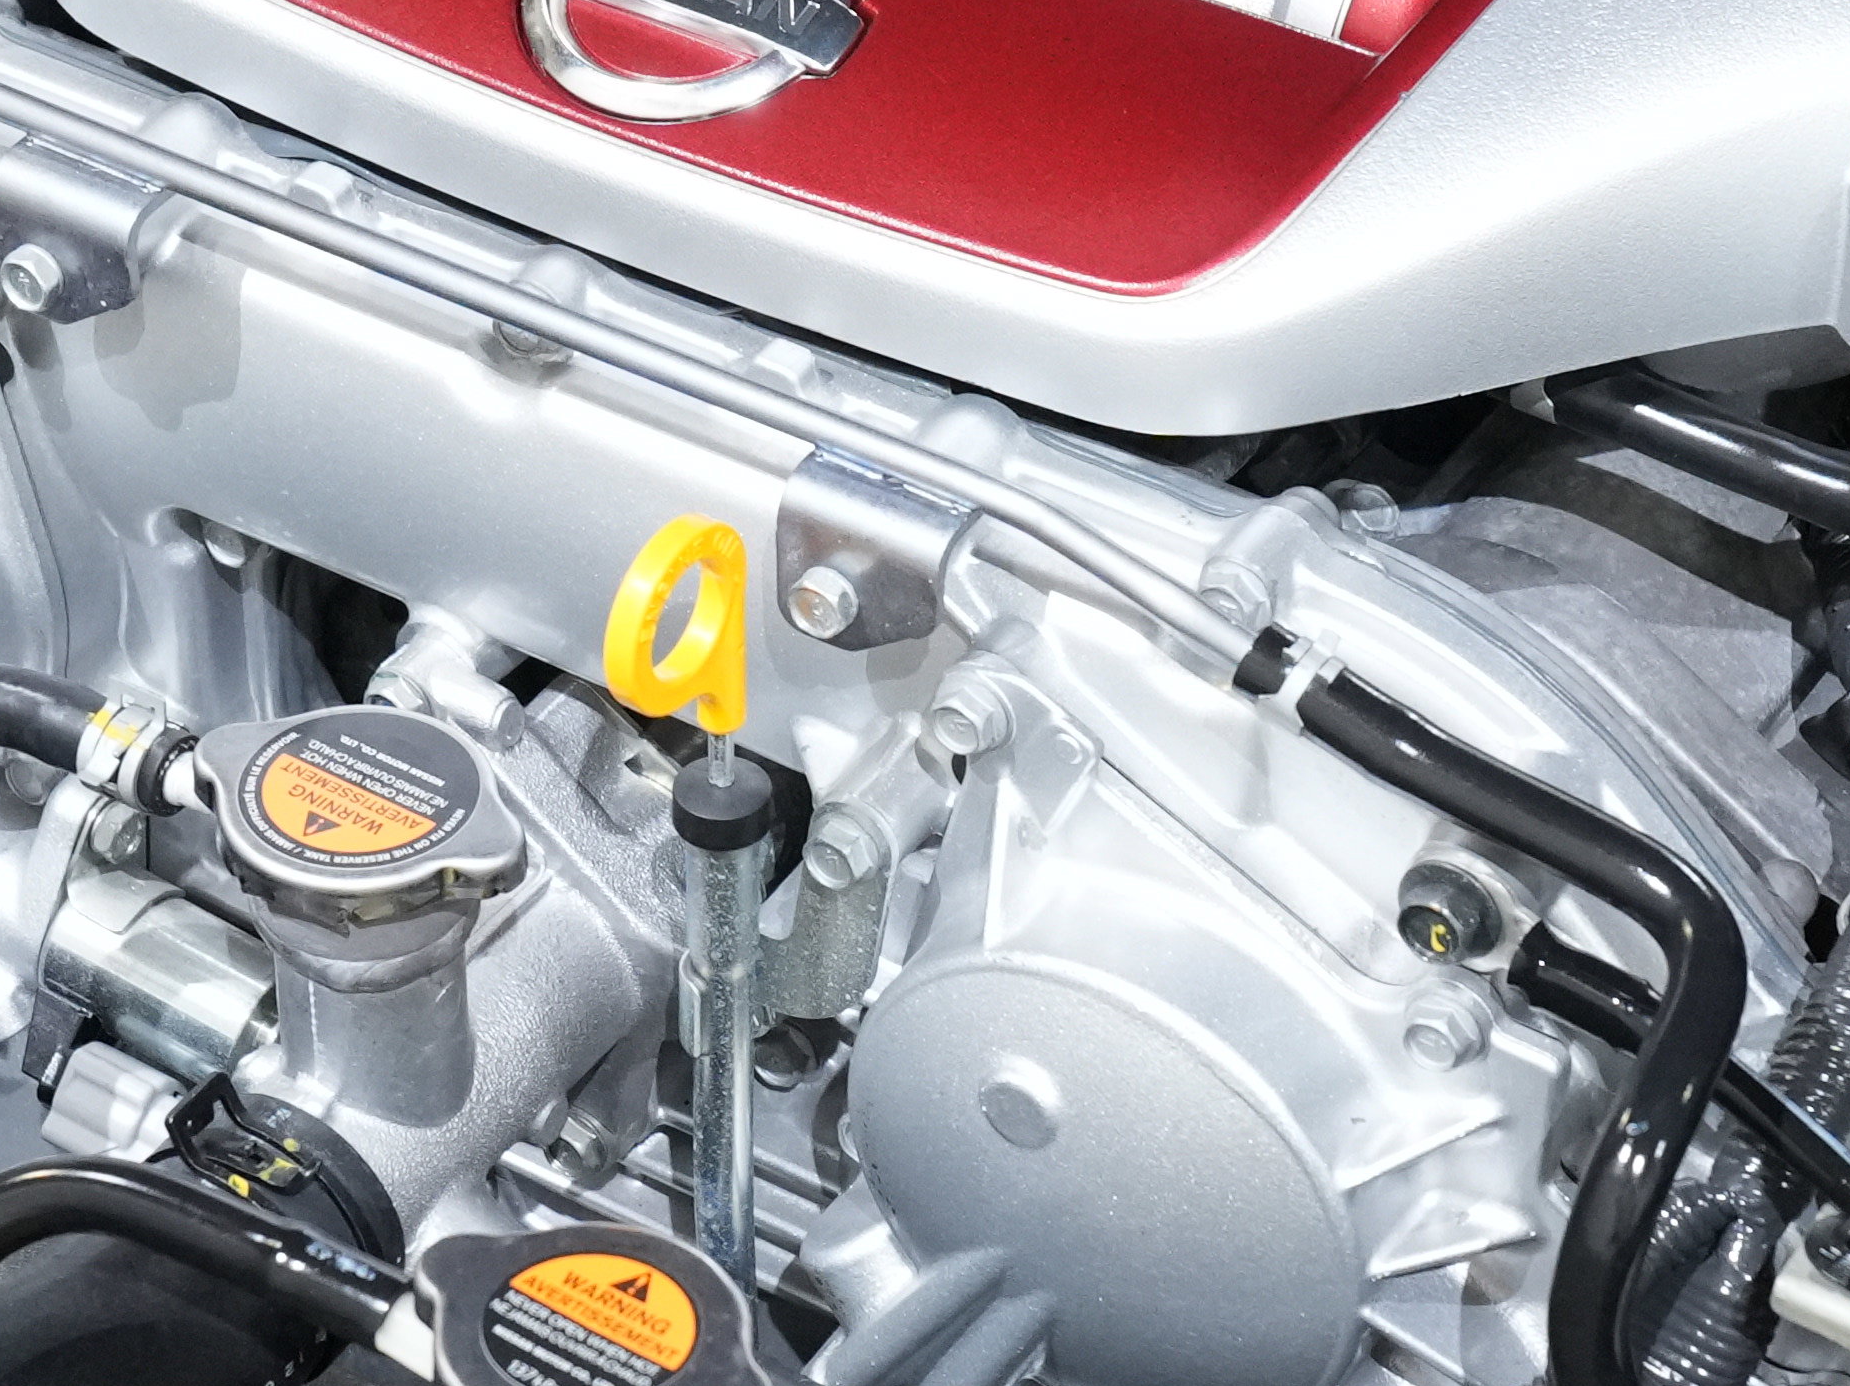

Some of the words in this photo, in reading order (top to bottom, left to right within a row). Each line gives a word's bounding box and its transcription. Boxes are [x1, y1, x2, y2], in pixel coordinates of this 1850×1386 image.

[326, 760, 364, 784] WHEN
[354, 760, 395, 785] OUVRIR
[376, 751, 410, 771] MOTOR
[362, 777, 399, 799] OPEN
[409, 766, 445, 787] NISSAN
[280, 761, 424, 829] AVERTISSEMENT
[393, 778, 435, 802] JAMAIS
[288, 784, 383, 835] WARNING
[395, 792, 436, 816] NEVER
[446, 808, 466, 831] NEVER
[392, 846, 413, 859] THE
[413, 840, 431, 852] ON
[563, 1270, 671, 1336] WARNING
[503, 1289, 552, 1321] NEVER
[548, 1313, 588, 1342] OPEN
[586, 1332, 632, 1363] WHEN
[523, 1274, 679, 1362] AVERTISSEMENT
